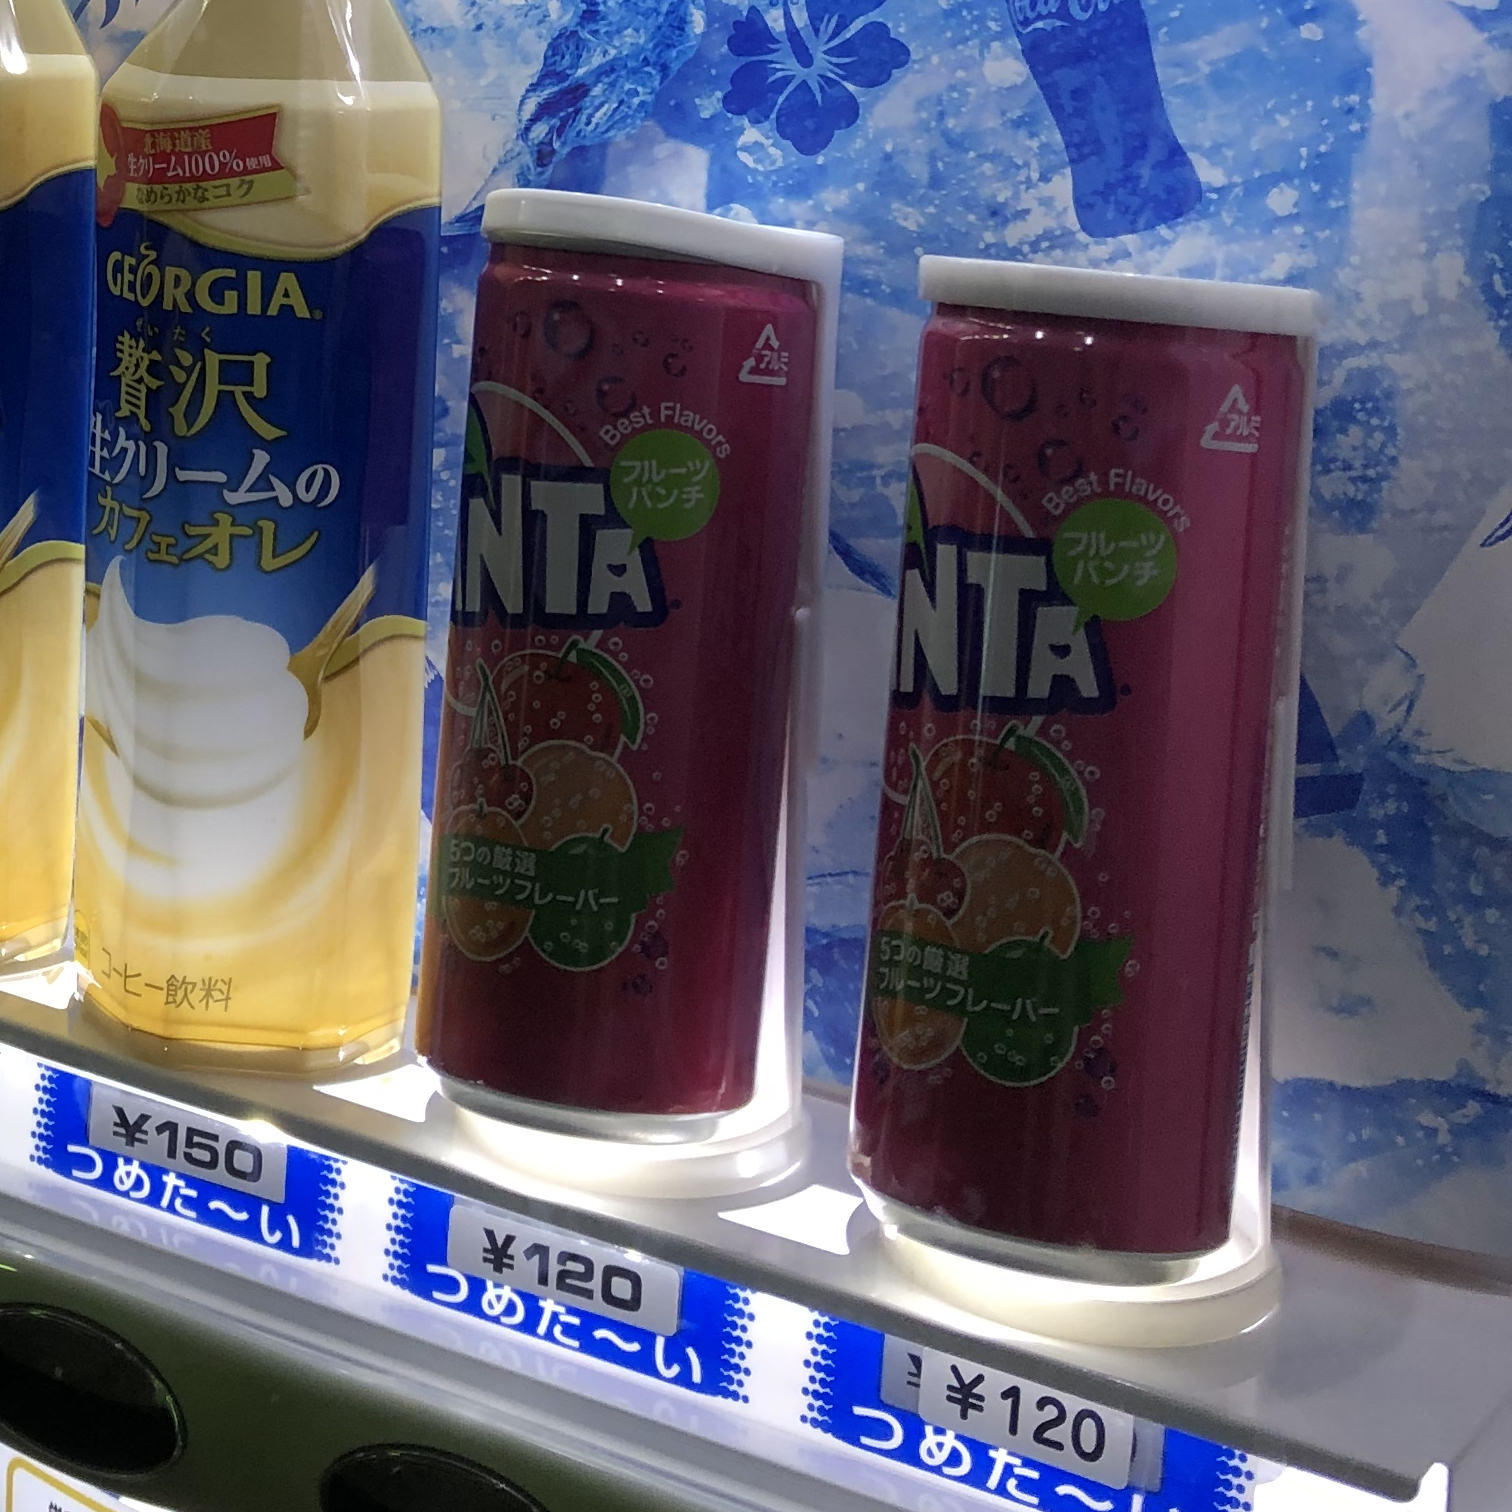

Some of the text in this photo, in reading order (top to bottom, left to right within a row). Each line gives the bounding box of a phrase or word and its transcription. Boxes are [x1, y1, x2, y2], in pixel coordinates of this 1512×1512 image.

[106, 243, 312, 320] GEORGIA
[109, 330, 288, 441] 贅沢
[88, 411, 341, 508] 生クリームの
[599, 402, 731, 459] Best Flavors
[619, 459, 711, 485] フルーツ
[628, 485, 705, 510] パンチ
[1041, 468, 1191, 534] Best Flavors
[92, 486, 320, 573] カフェオレ
[1061, 531, 1166, 559] フルーツ
[1074, 560, 1159, 587] パンチ
[111, 1106, 263, 1184] ¥150
[481, 1227, 642, 1314] ¥120
[946, 1363, 1106, 1464] ¥120
